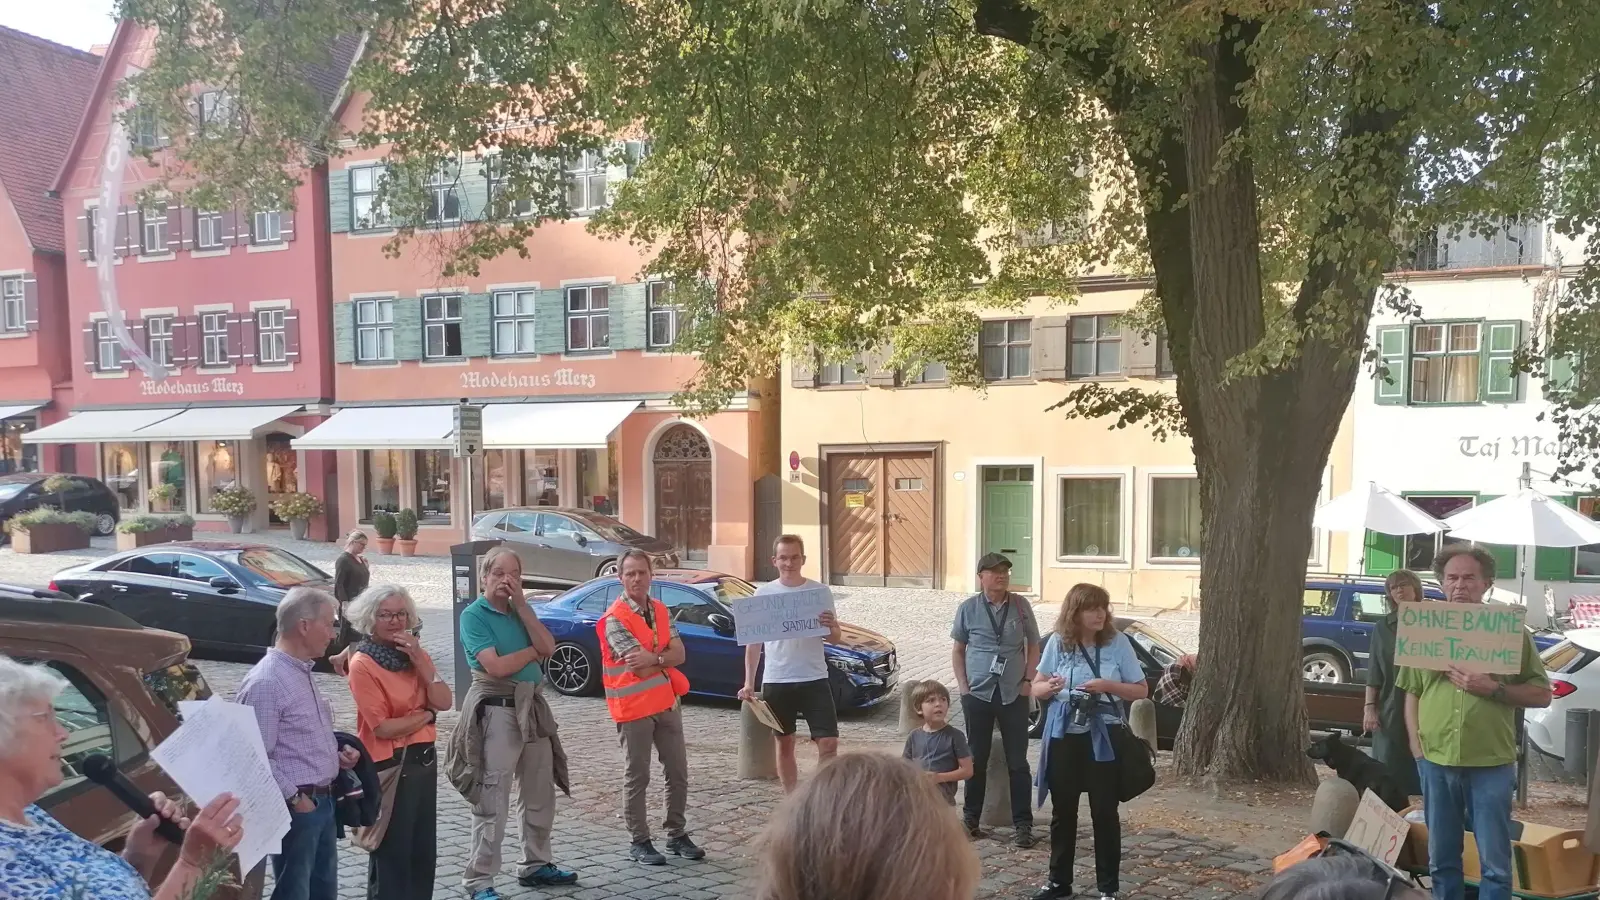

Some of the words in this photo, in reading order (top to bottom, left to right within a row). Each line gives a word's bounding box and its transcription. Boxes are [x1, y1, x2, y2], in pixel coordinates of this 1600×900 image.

[140, 380, 210, 396] Modehaus
[212, 378, 244, 396] Merz
[460, 370, 551, 388] Modehaus
[554, 368, 596, 388] Merz
[1458, 436, 1501, 461] Taj
[1402, 606, 1460, 630] OHNE
[1462, 607, 1521, 634] BÄUME
[1398, 636, 1444, 657] KEINE
[1444, 637, 1519, 665] TRÄUME
